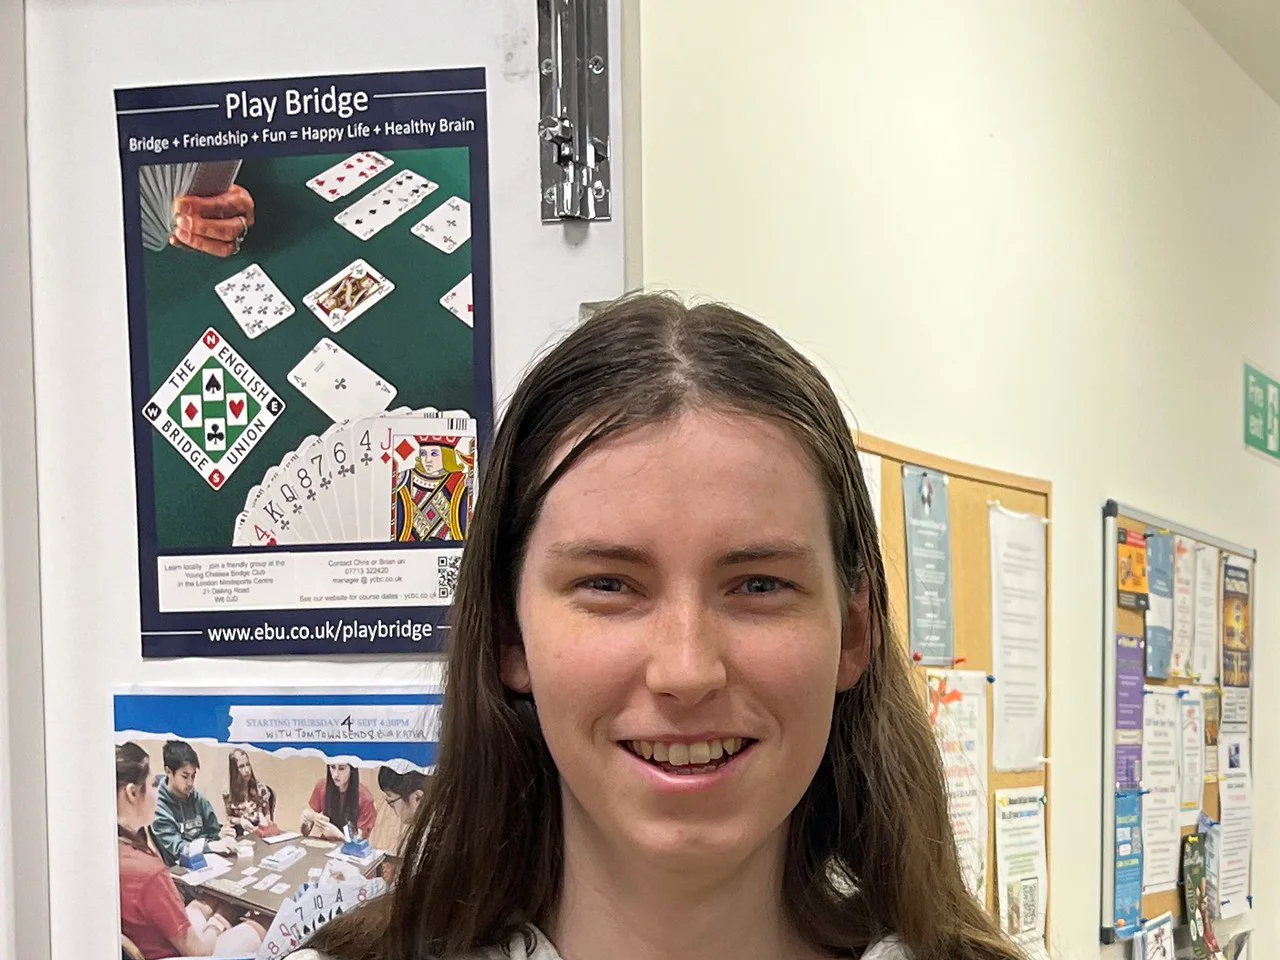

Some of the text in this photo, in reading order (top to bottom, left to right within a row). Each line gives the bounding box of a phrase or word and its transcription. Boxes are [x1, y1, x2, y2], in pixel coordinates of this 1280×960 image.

[225, 85, 369, 123] Play Bridge
[129, 136, 169, 153] Bridge
[172, 137, 180, 148] +
[183, 130, 249, 149] Friendship
[251, 132, 259, 142] +
[262, 128, 287, 142] Fun
[301, 126, 344, 142] Happy
[347, 122, 370, 138] Life
[373, 124, 381, 135] +
[384, 119, 436, 136] Healthy
[439, 117, 475, 132] Brain
[206, 335, 216, 345] N
[169, 359, 196, 389] THE
[217, 346, 269, 402] ENGLISH
[145, 406, 158, 417] W
[271, 401, 279, 412] E
[161, 419, 209, 471] BRIDGE
[226, 418, 266, 465] UNION
[360, 429, 371, 451] 4
[380, 427, 392, 450] J
[334, 441, 346, 464] 6
[310, 454, 323, 477] 7
[212, 473, 220, 483] S
[297, 468, 312, 488] 8
[280, 483, 297, 503] Q
[263, 500, 284, 524] K
[253, 524, 270, 541] 4
[328, 559, 352, 567] Contact
[207, 619, 433, 642] www.ebu.co.uk/playbridge
[246, 719, 290, 727] STARTING
[291, 719, 340, 727] THURSDAY
[357, 719, 376, 727] SEPT
[380, 719, 409, 727] 4:30PM
[265, 729, 292, 739] WITH
[313, 895, 323, 910] 10
[335, 888, 343, 902] A
[295, 907, 304, 921] 7
[268, 941, 279, 955] 8
